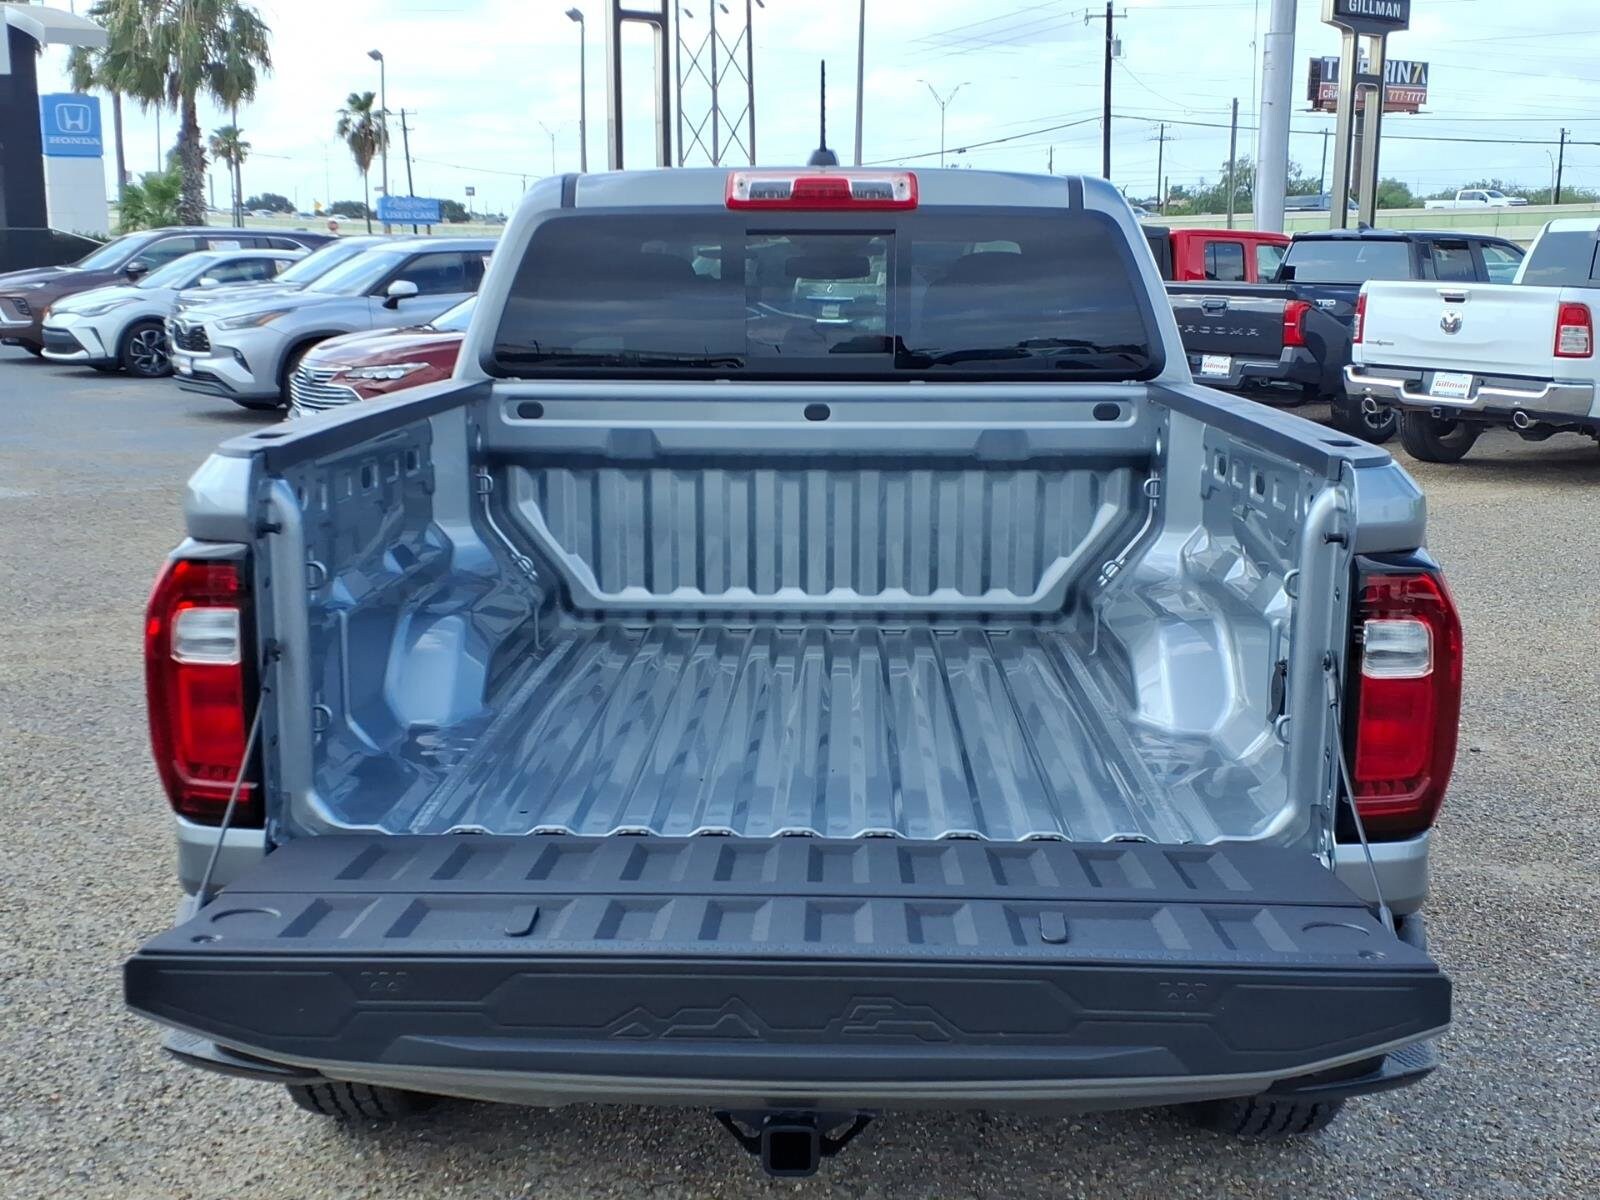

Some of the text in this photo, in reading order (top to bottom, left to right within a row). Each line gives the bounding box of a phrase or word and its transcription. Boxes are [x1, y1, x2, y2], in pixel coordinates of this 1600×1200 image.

[1348, 0, 1401, 18] GILLMAN
[1388, 90, 1426, 102] 777-7777
[49, 136, 100, 144] HONDA
